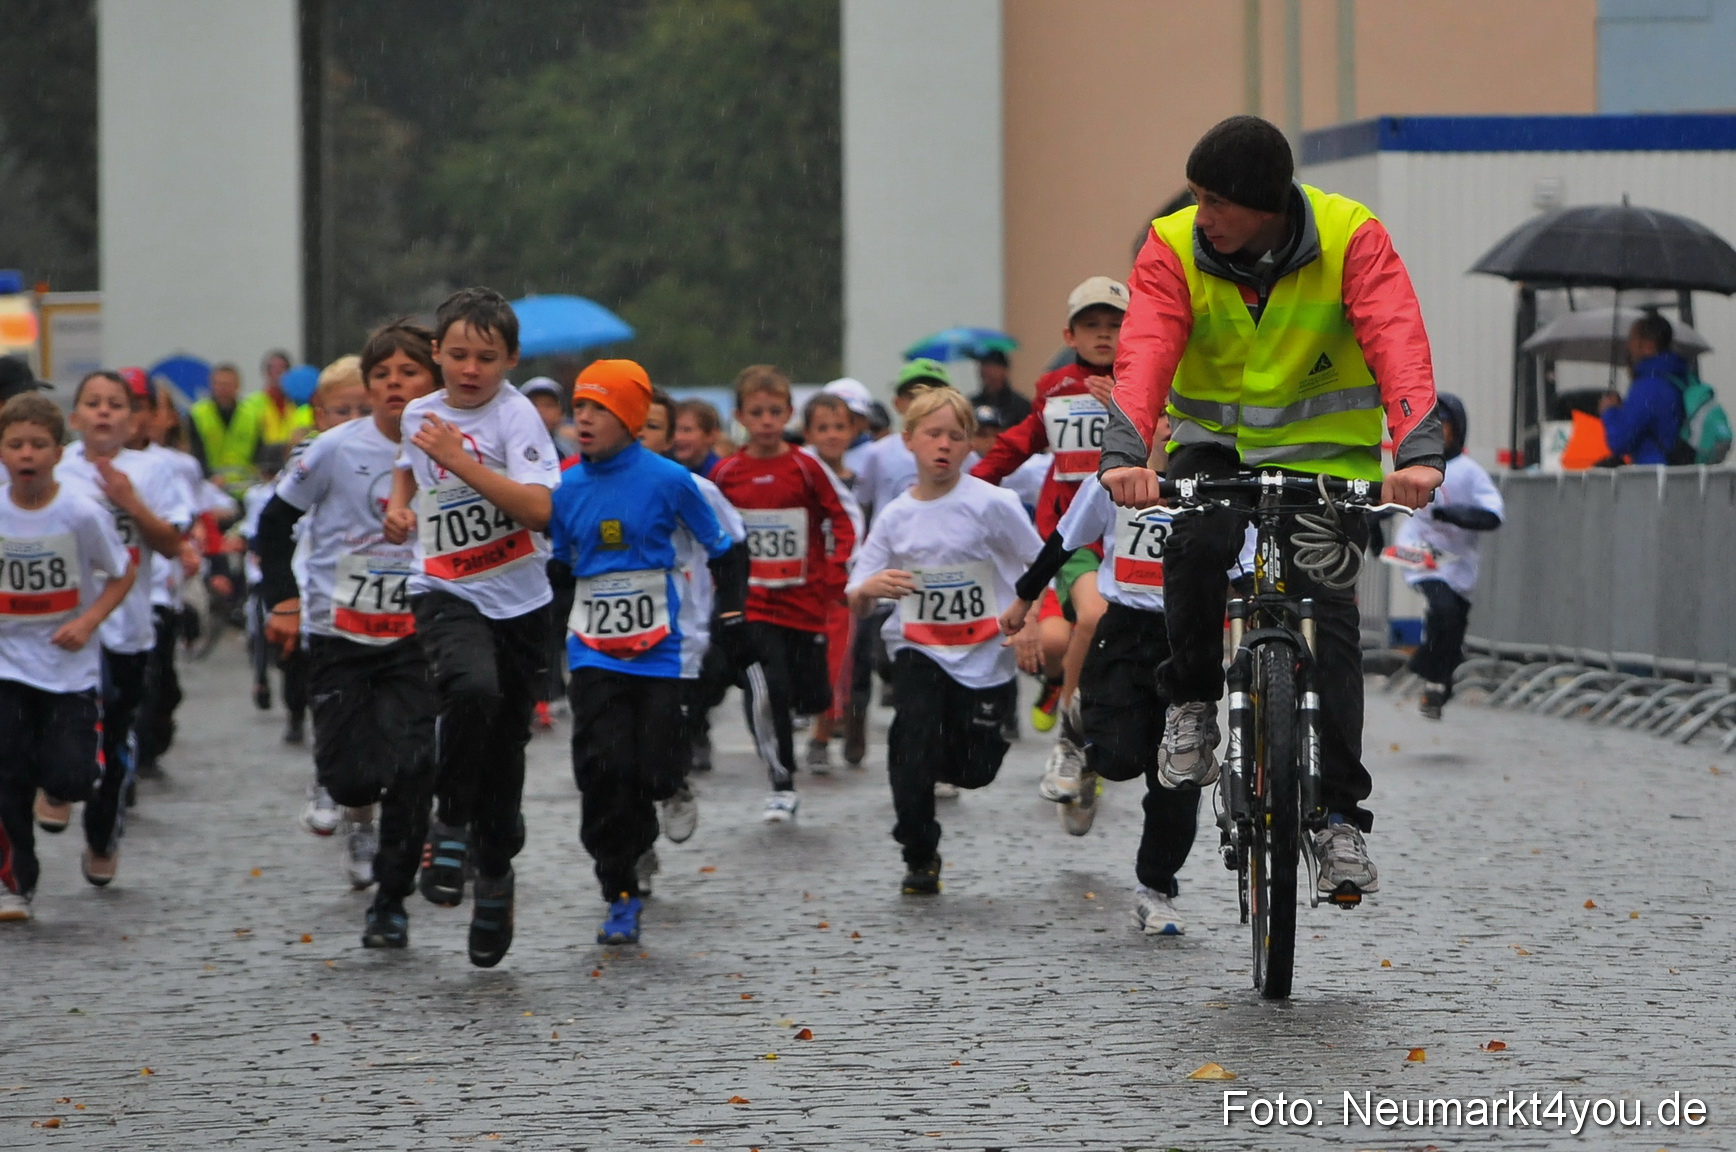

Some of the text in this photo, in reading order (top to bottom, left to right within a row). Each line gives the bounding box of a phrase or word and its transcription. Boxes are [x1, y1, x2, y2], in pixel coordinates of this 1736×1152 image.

[1128, 521, 1167, 558] 73
[0, 557, 67, 590] 058
[349, 574, 408, 610] 714
[913, 585, 984, 620] 7248
[582, 595, 654, 634] 7230
